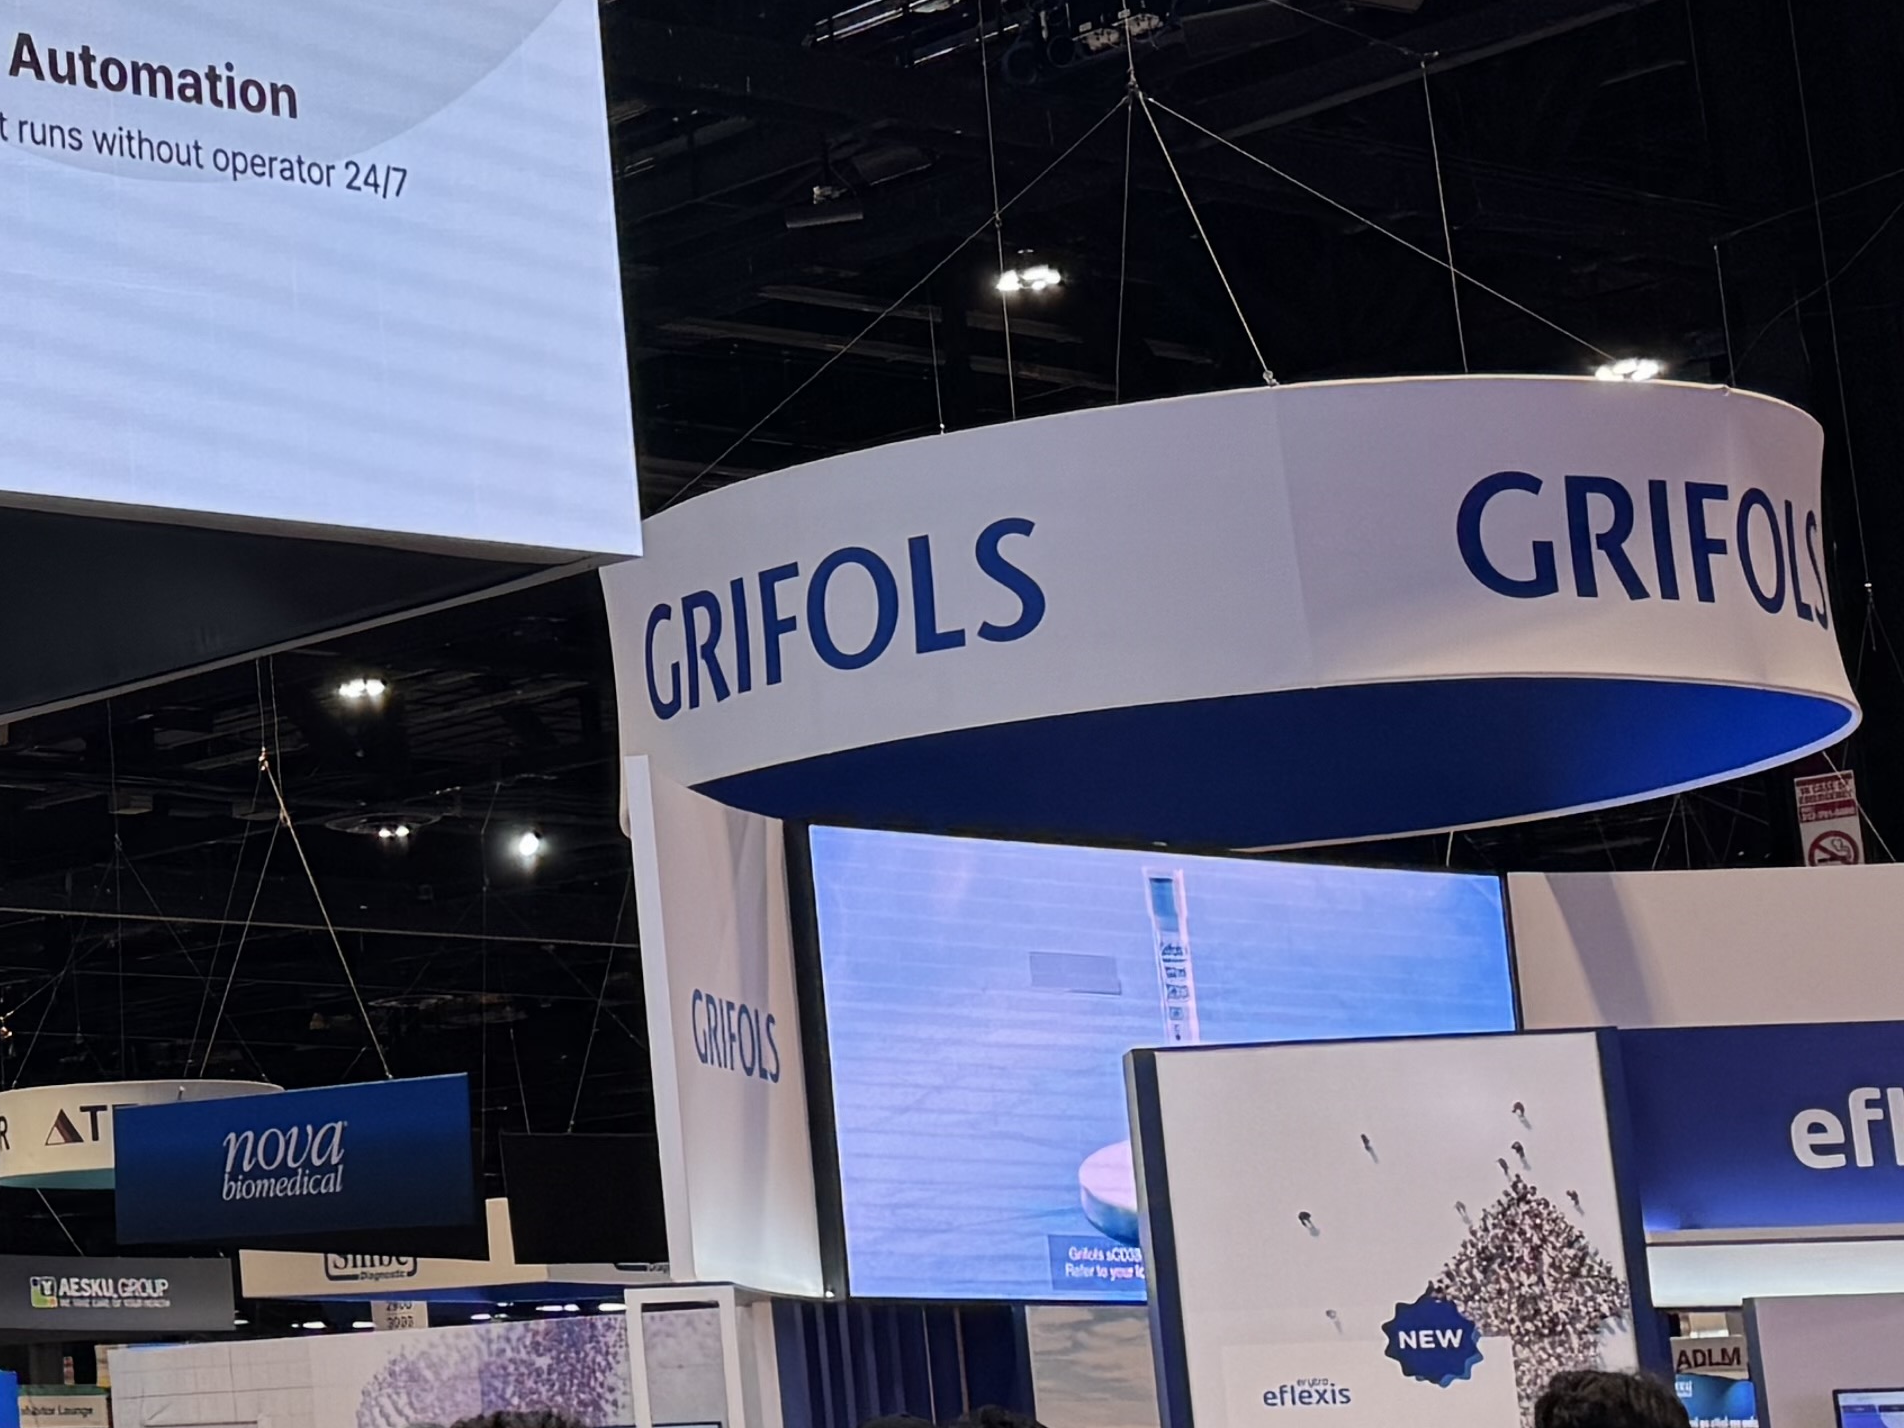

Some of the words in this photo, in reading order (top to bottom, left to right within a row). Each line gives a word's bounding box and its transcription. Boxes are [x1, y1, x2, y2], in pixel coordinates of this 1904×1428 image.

[9, 32, 298, 119] Automation
[17, 121, 84, 152] runs
[92, 125, 204, 169] without
[212, 148, 336, 189] operator
[345, 159, 408, 198] 24/7
[1456, 470, 1830, 632] GRIFOLS
[643, 517, 1046, 722] GRIFOLS
[691, 988, 781, 1086] GRIFOLS
[223, 1120, 345, 1172] nova
[223, 1164, 343, 1201] biomedical
[1398, 1329, 1463, 1349] NEW
[1677, 1347, 1741, 1370] ADLM
[1263, 1383, 1352, 1406] eflexis
